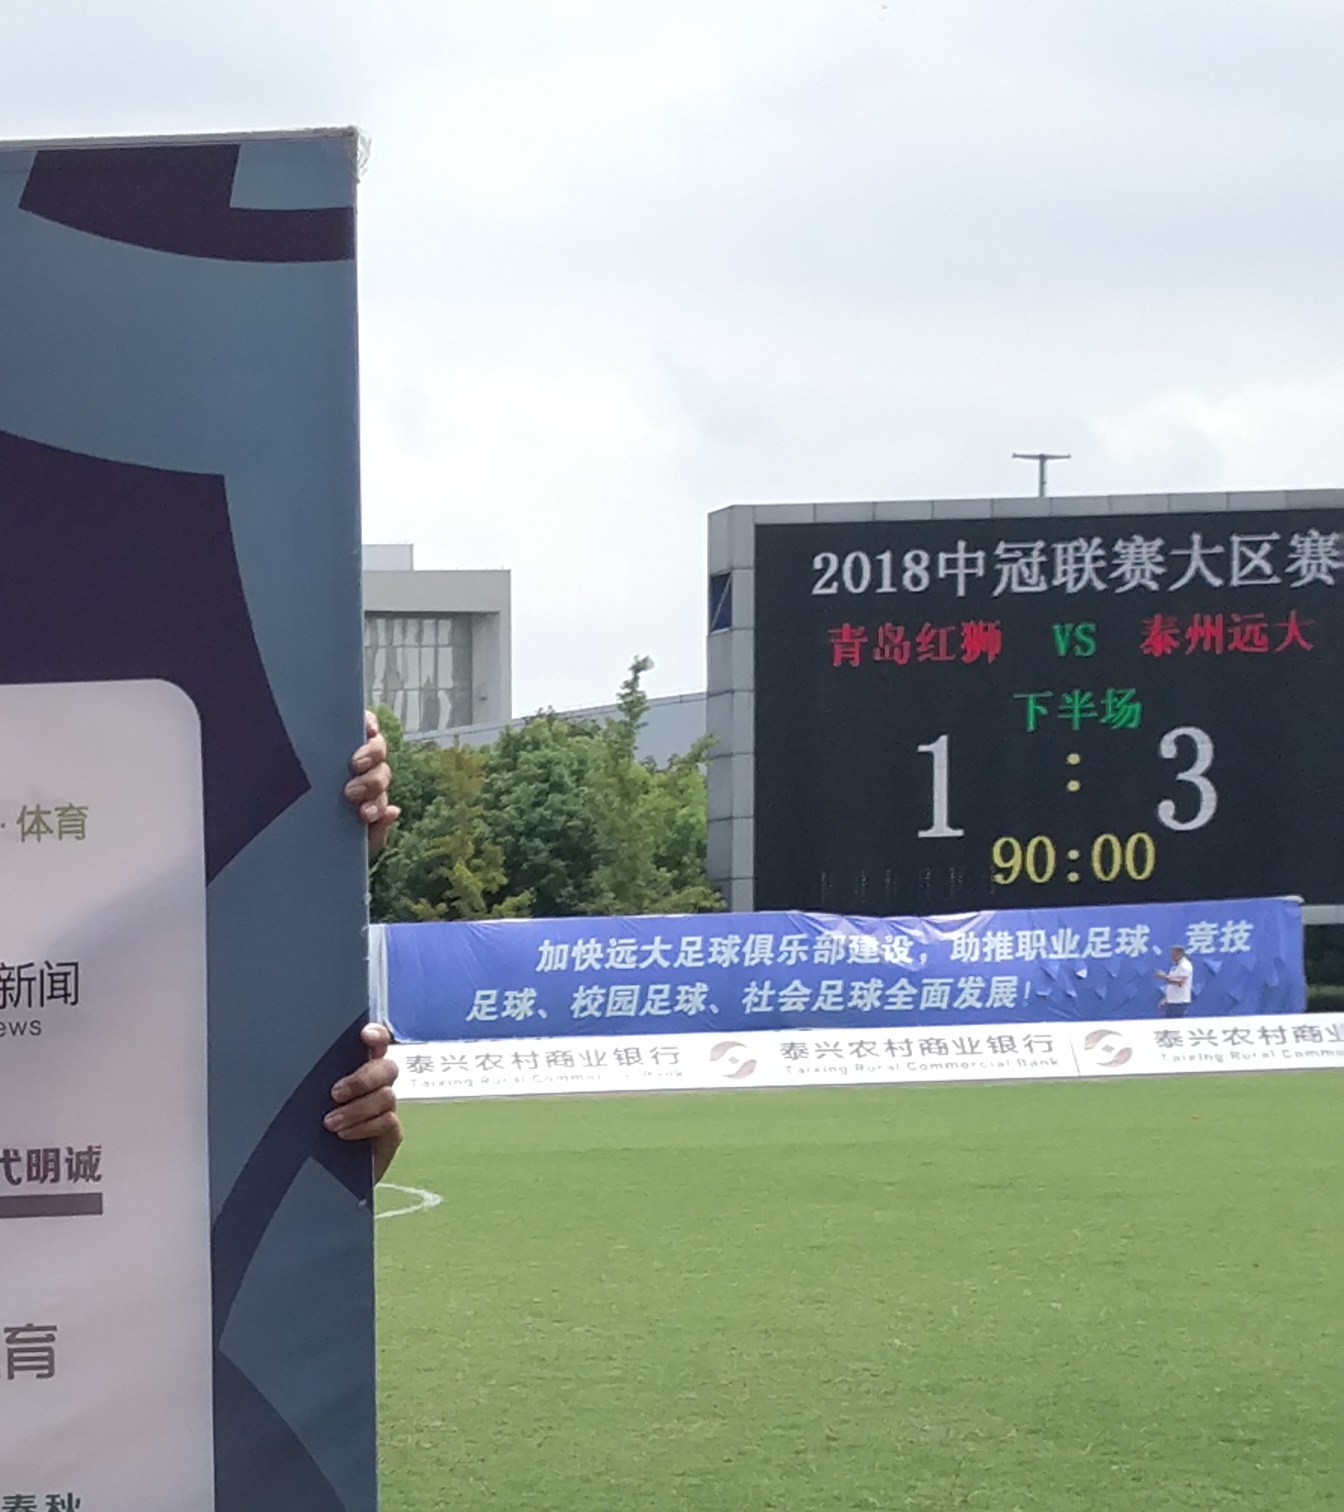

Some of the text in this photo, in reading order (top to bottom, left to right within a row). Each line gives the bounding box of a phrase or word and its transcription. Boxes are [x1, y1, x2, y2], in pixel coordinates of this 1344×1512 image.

[812, 527, 1344, 597] 2018中冠联赛大区赛
[828, 619, 1003, 667] 青岛红狮
[1052, 622, 1096, 657] VS
[1139, 609, 1314, 657] 泰州远大
[1013, 688, 1143, 732] 下半场
[992, 832, 1156, 885] 90:00
[405, 1046, 680, 1074] 泰兴农村商业银行
[779, 1034, 1055, 1061] 泰兴农村商业银行
[907, 1059, 1011, 1072] Commercial
